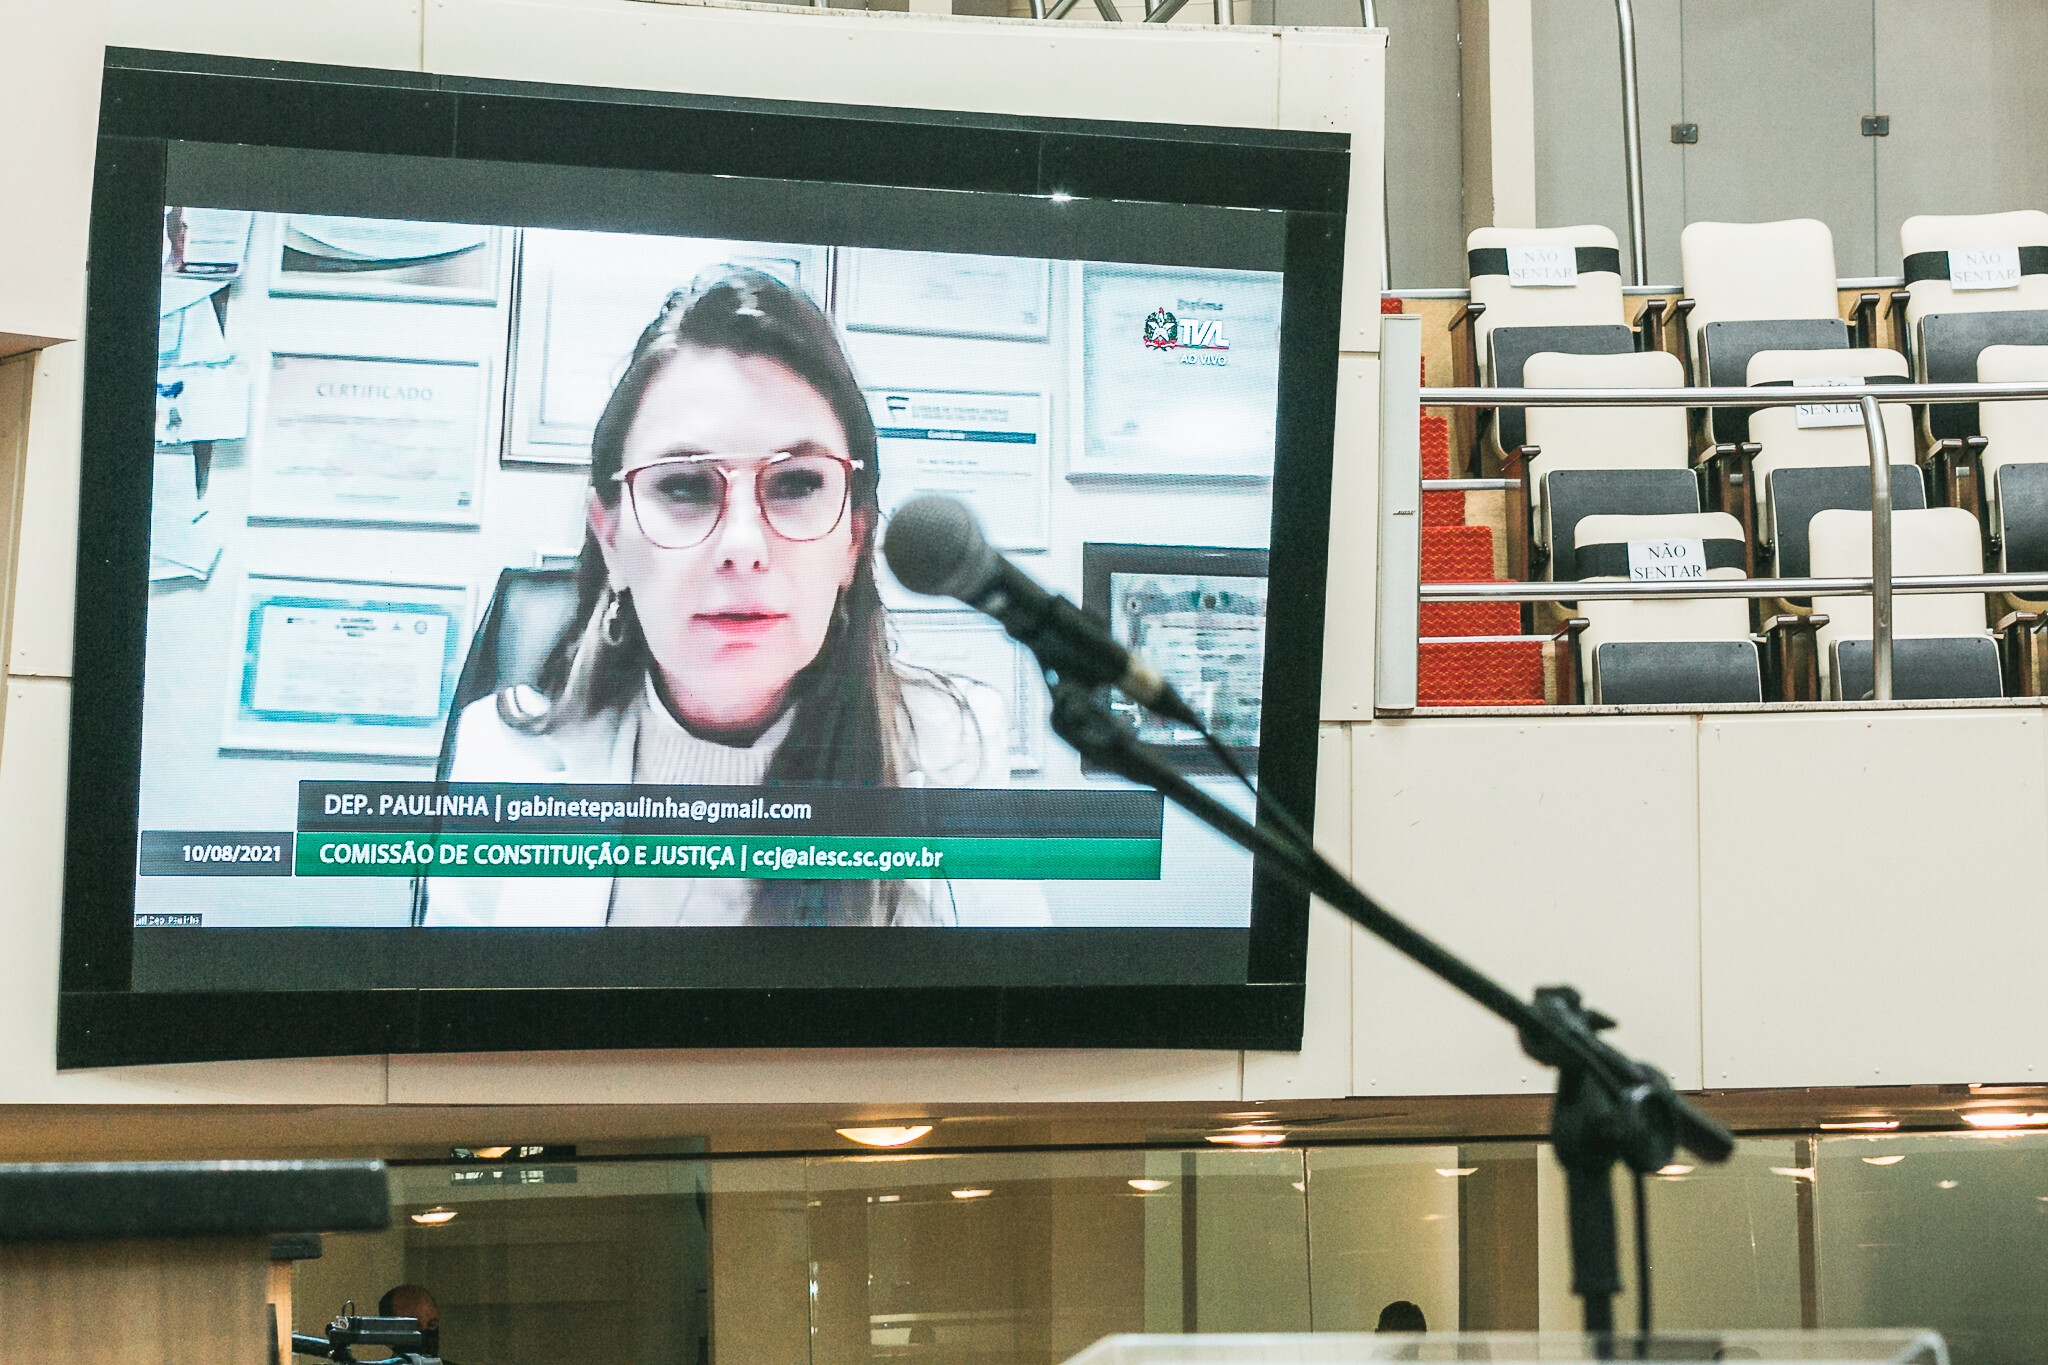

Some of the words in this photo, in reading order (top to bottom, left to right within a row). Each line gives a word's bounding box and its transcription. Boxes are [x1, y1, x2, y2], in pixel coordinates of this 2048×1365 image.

[1966, 251, 2001, 266] NÃO
[1512, 267, 1572, 279] SENTAR
[1953, 269, 2016, 283] SENTAR
[1180, 353, 1197, 365] AO
[1199, 354, 1227, 367] VIVO
[316, 383, 433, 401] CERTIFICADO
[1648, 542, 1686, 560] NÃO
[1634, 564, 1703, 579] SENTAR
[324, 793, 374, 816] DEP.
[379, 793, 489, 817] PAULINHA
[507, 795, 812, 824] gabinetepaulinha@gmail.com
[182, 843, 282, 863] 10/08/2021
[319, 840, 434, 865] COMISSÃO
[439, 844, 468, 865] DE
[473, 841, 629, 870] CONSTITUIÇÃO
[634, 844, 646, 865] E
[651, 845, 735, 871] JUSTIÇA
[752, 846, 943, 871] ccj@alesc.sc.gov.br
